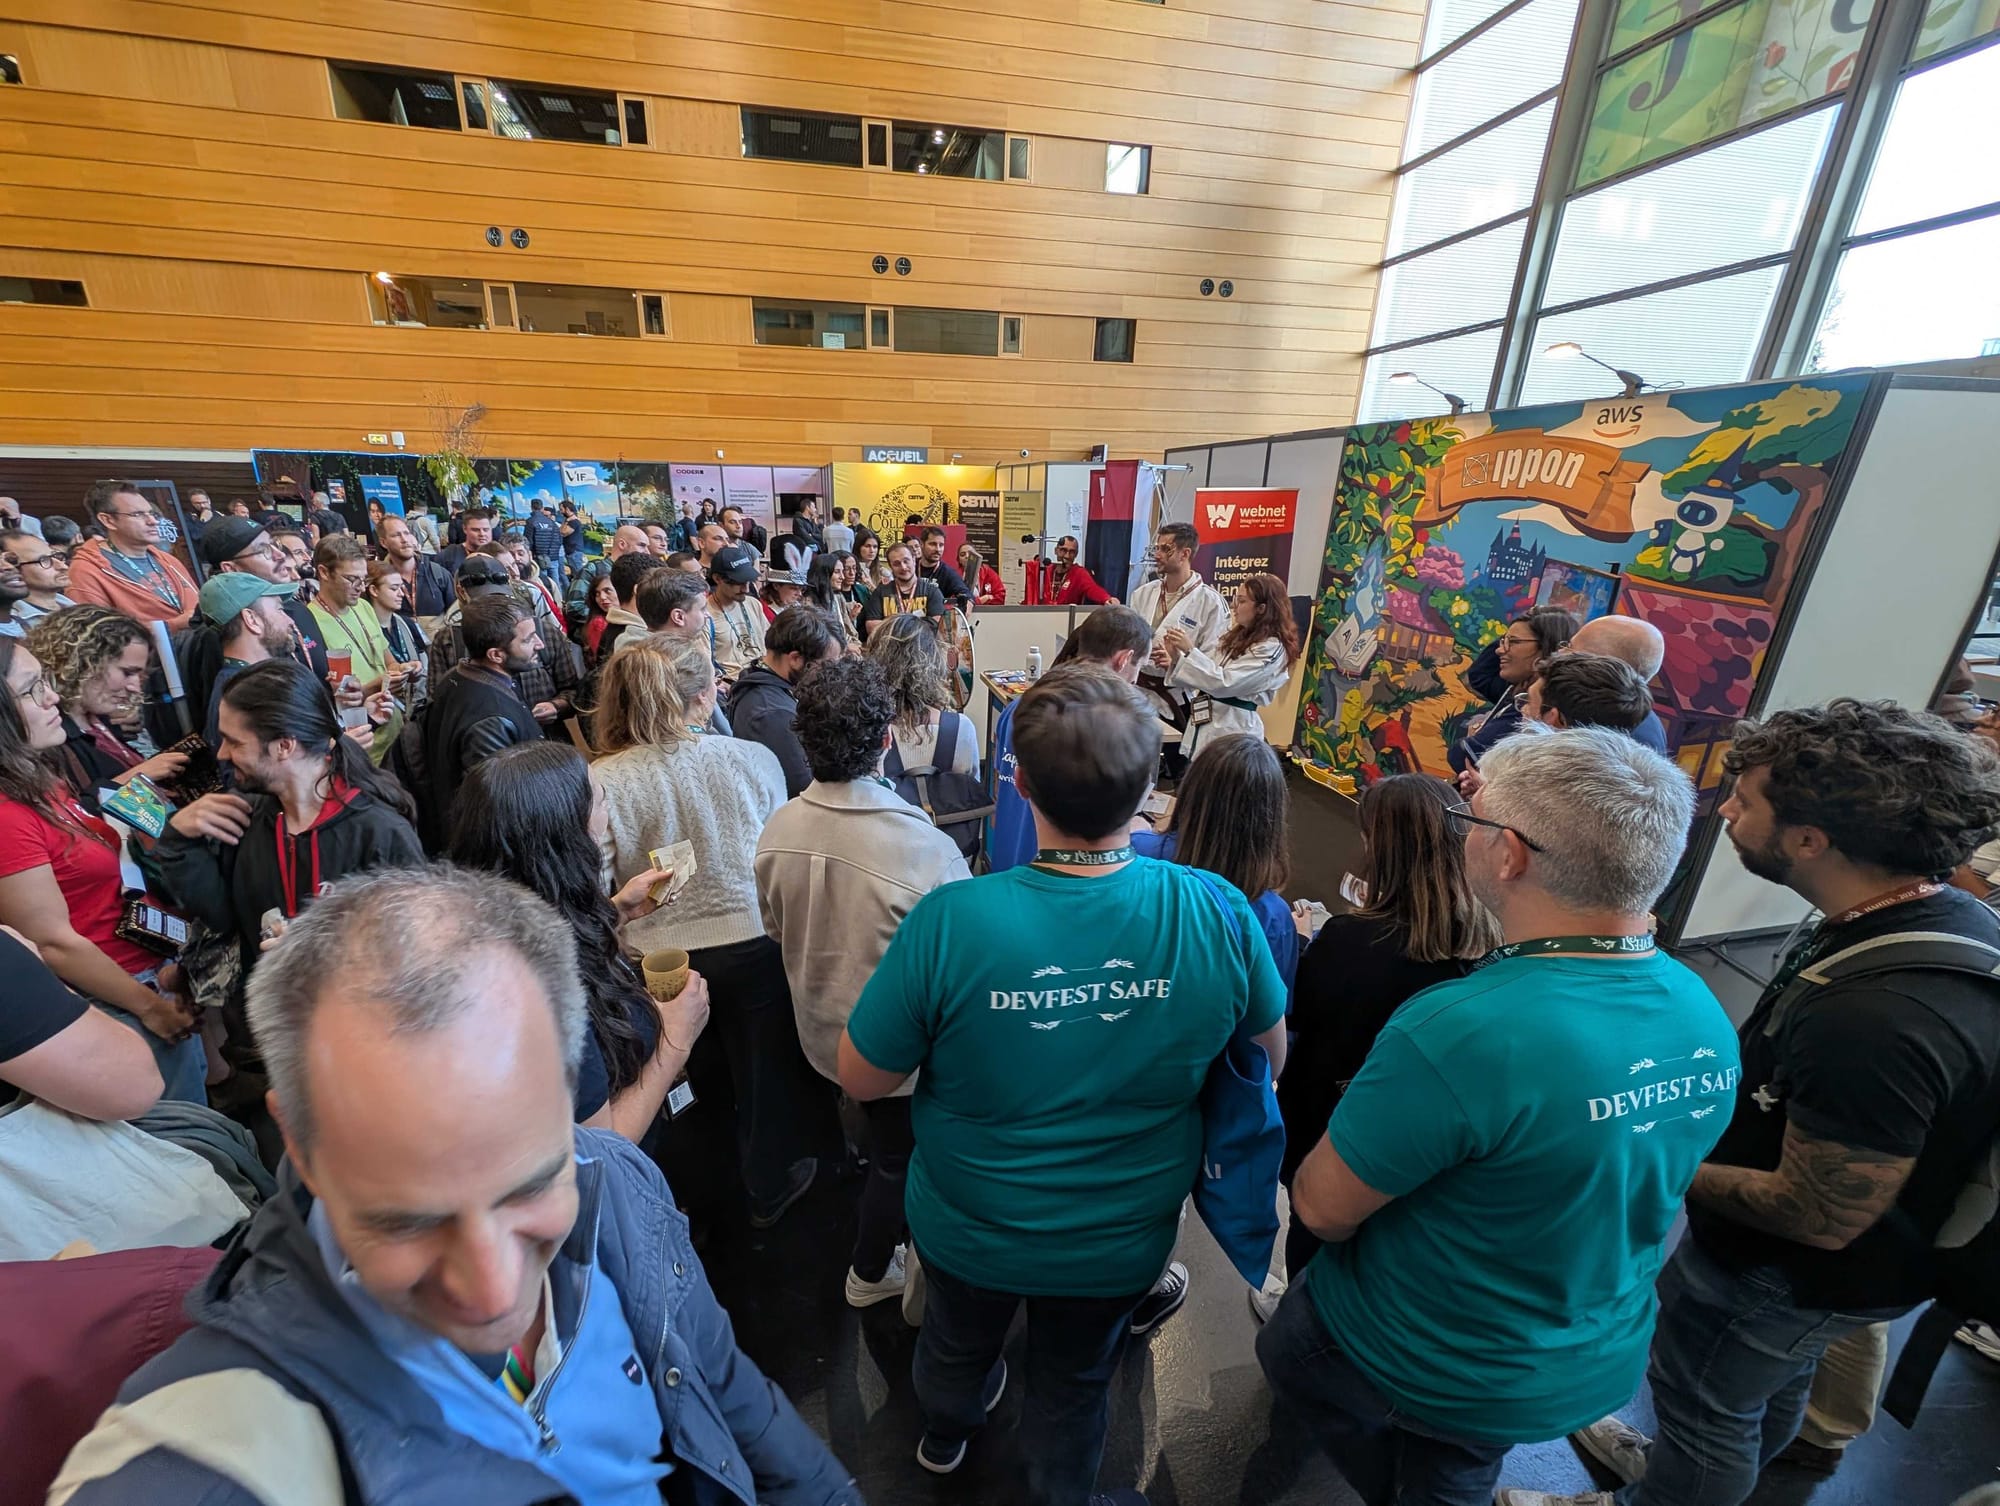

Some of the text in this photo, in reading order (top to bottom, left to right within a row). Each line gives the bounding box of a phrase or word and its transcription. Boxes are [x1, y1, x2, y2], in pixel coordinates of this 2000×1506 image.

[1597, 405, 1644, 424] aws
[867, 450, 924, 463] ACCUEIL
[1492, 448, 1585, 489] ippon
[959, 495, 999, 508] CBTW
[1239, 504, 1286, 518] webnet
[1215, 555, 1269, 570] Intégrez
[989, 978, 1171, 1011] DEVFEST SAFE
[1587, 1075, 1696, 1122] DEVFEST
